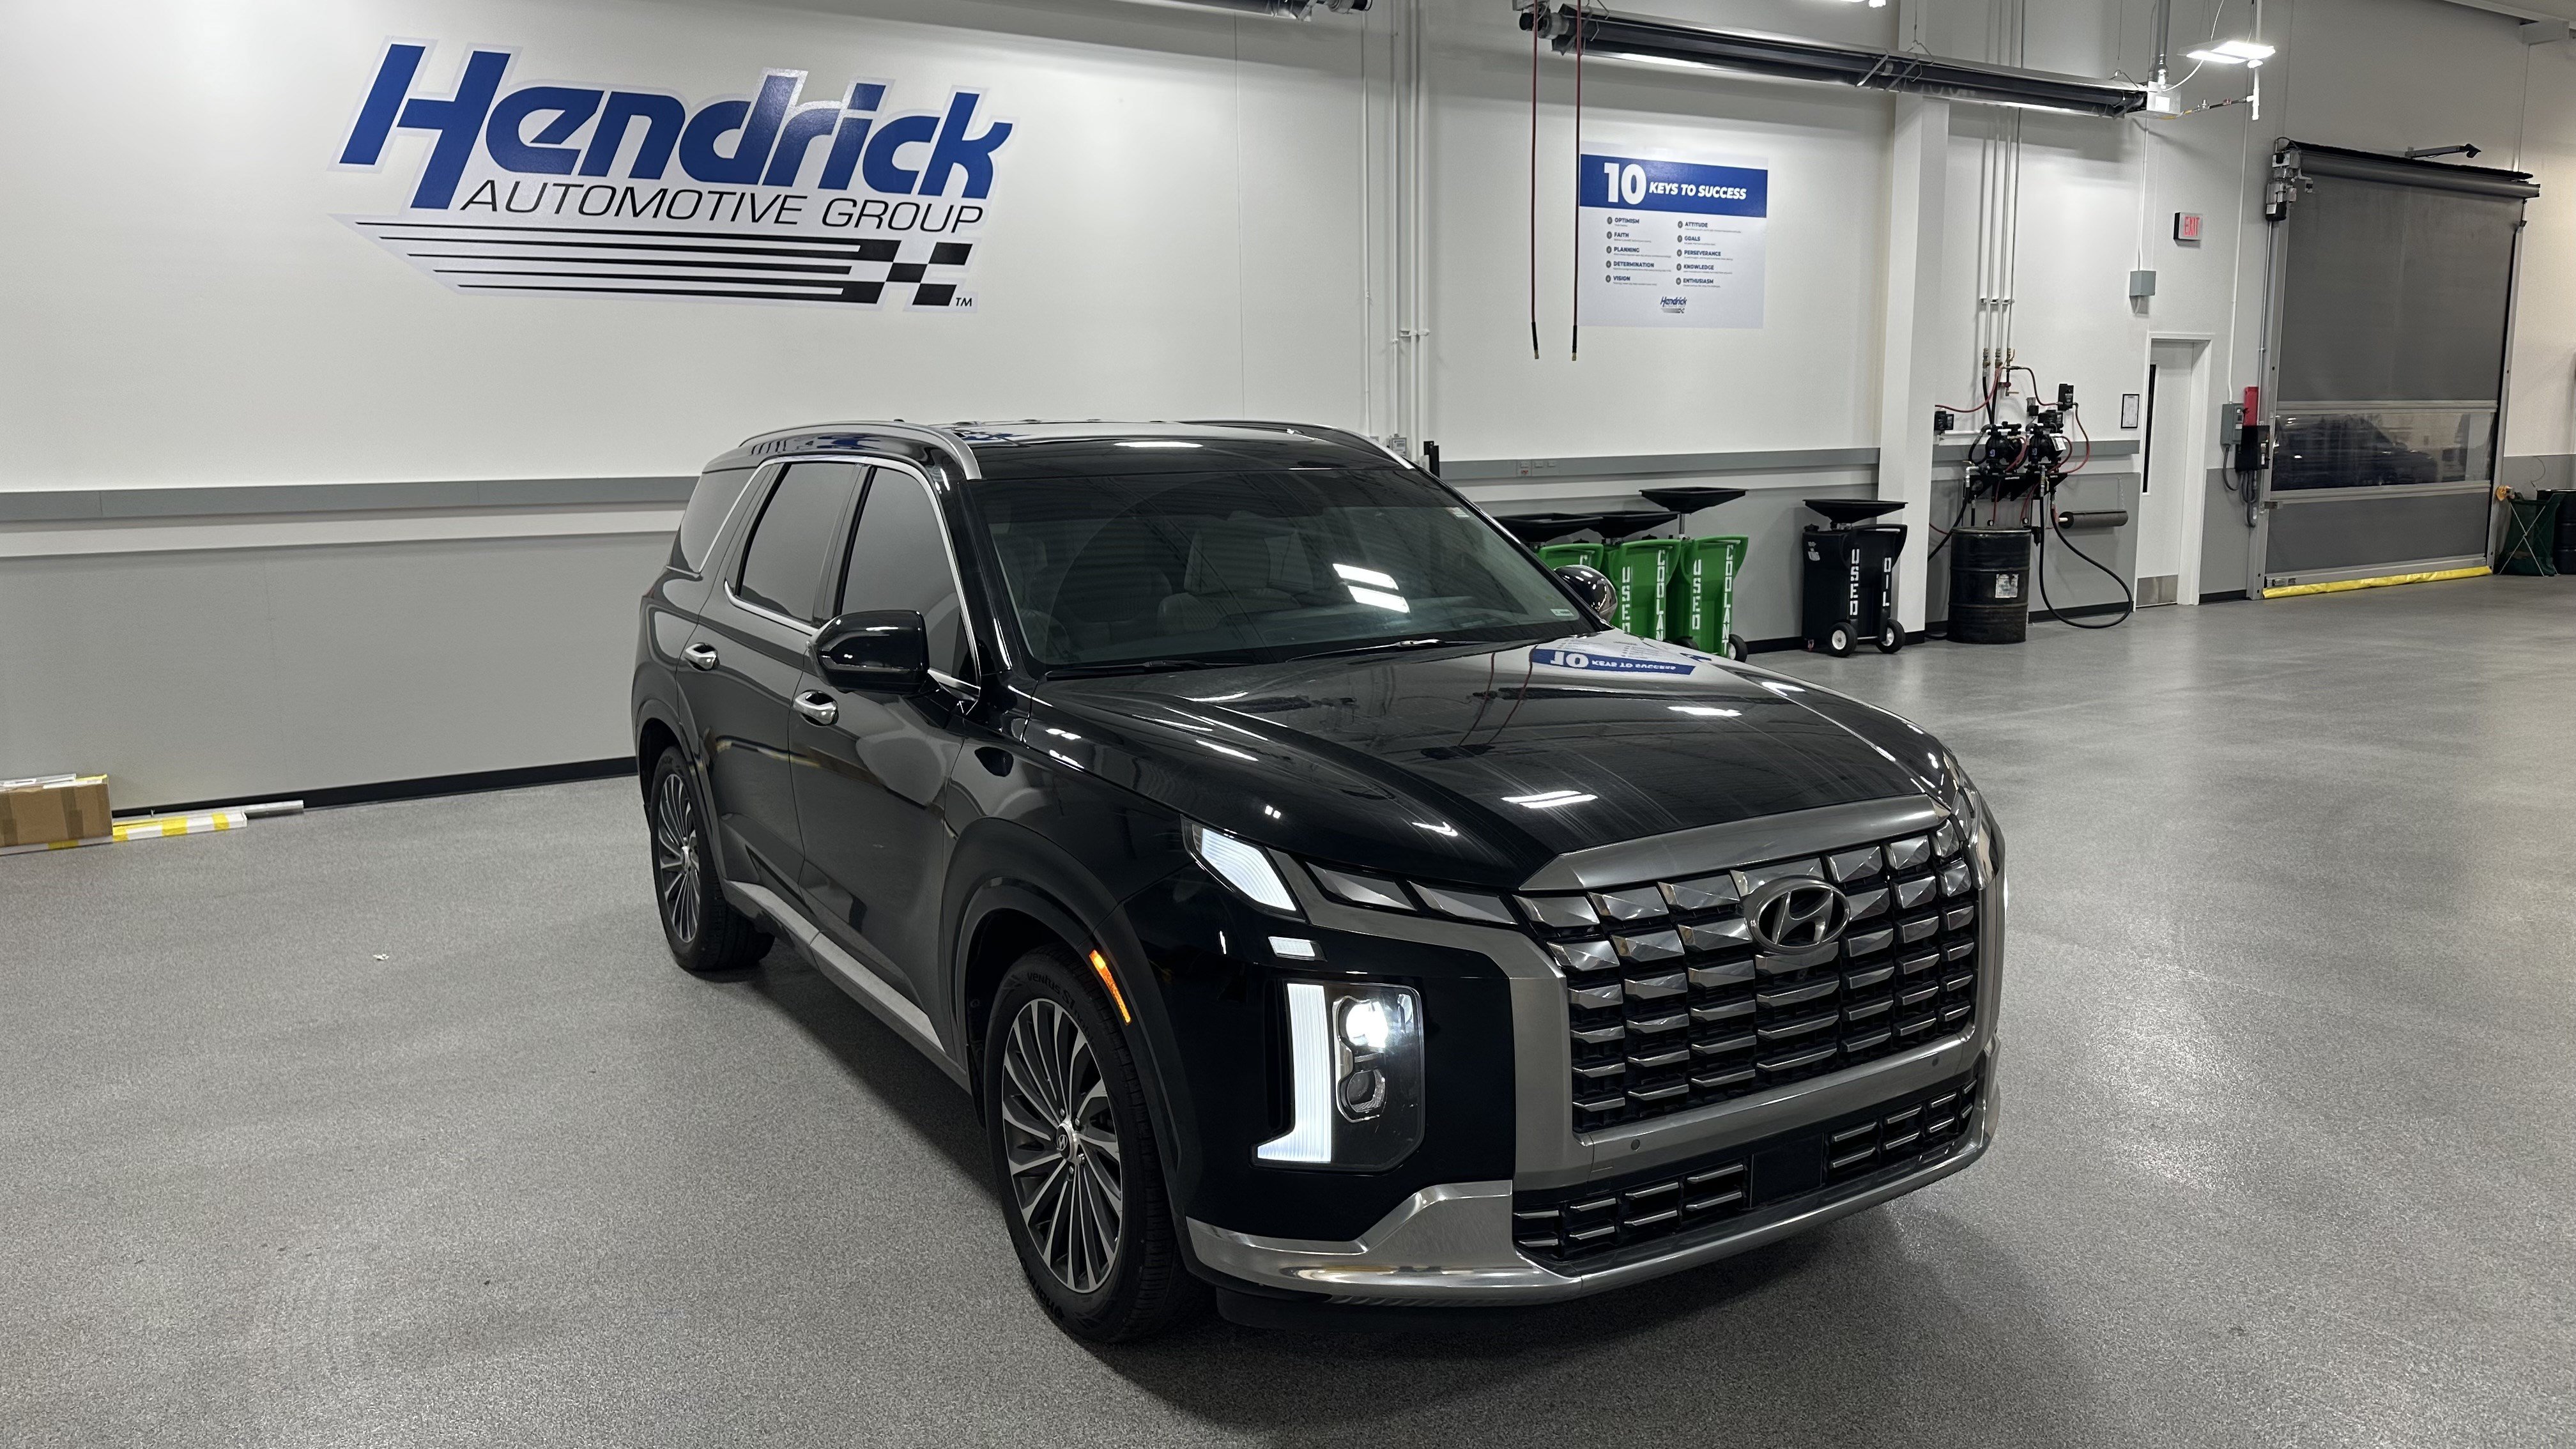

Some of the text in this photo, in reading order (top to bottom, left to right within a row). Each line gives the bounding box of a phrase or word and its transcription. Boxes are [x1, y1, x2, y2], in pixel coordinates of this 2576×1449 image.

[339, 43, 1013, 210] Hendrick
[460, 179, 983, 234] AUTOMOTIVE GROUP
[1604, 162, 1747, 205] 10 KEYS TO SUCCESS
[2184, 216, 2200, 236] EXIT
[956, 297, 972, 307] TM
[1656, 549, 1666, 641] COOLAN
[1692, 559, 1701, 630] USED
[1722, 544, 1734, 656] COOLANT
[1850, 548, 1860, 615] USED
[1882, 557, 1892, 607] OIL
